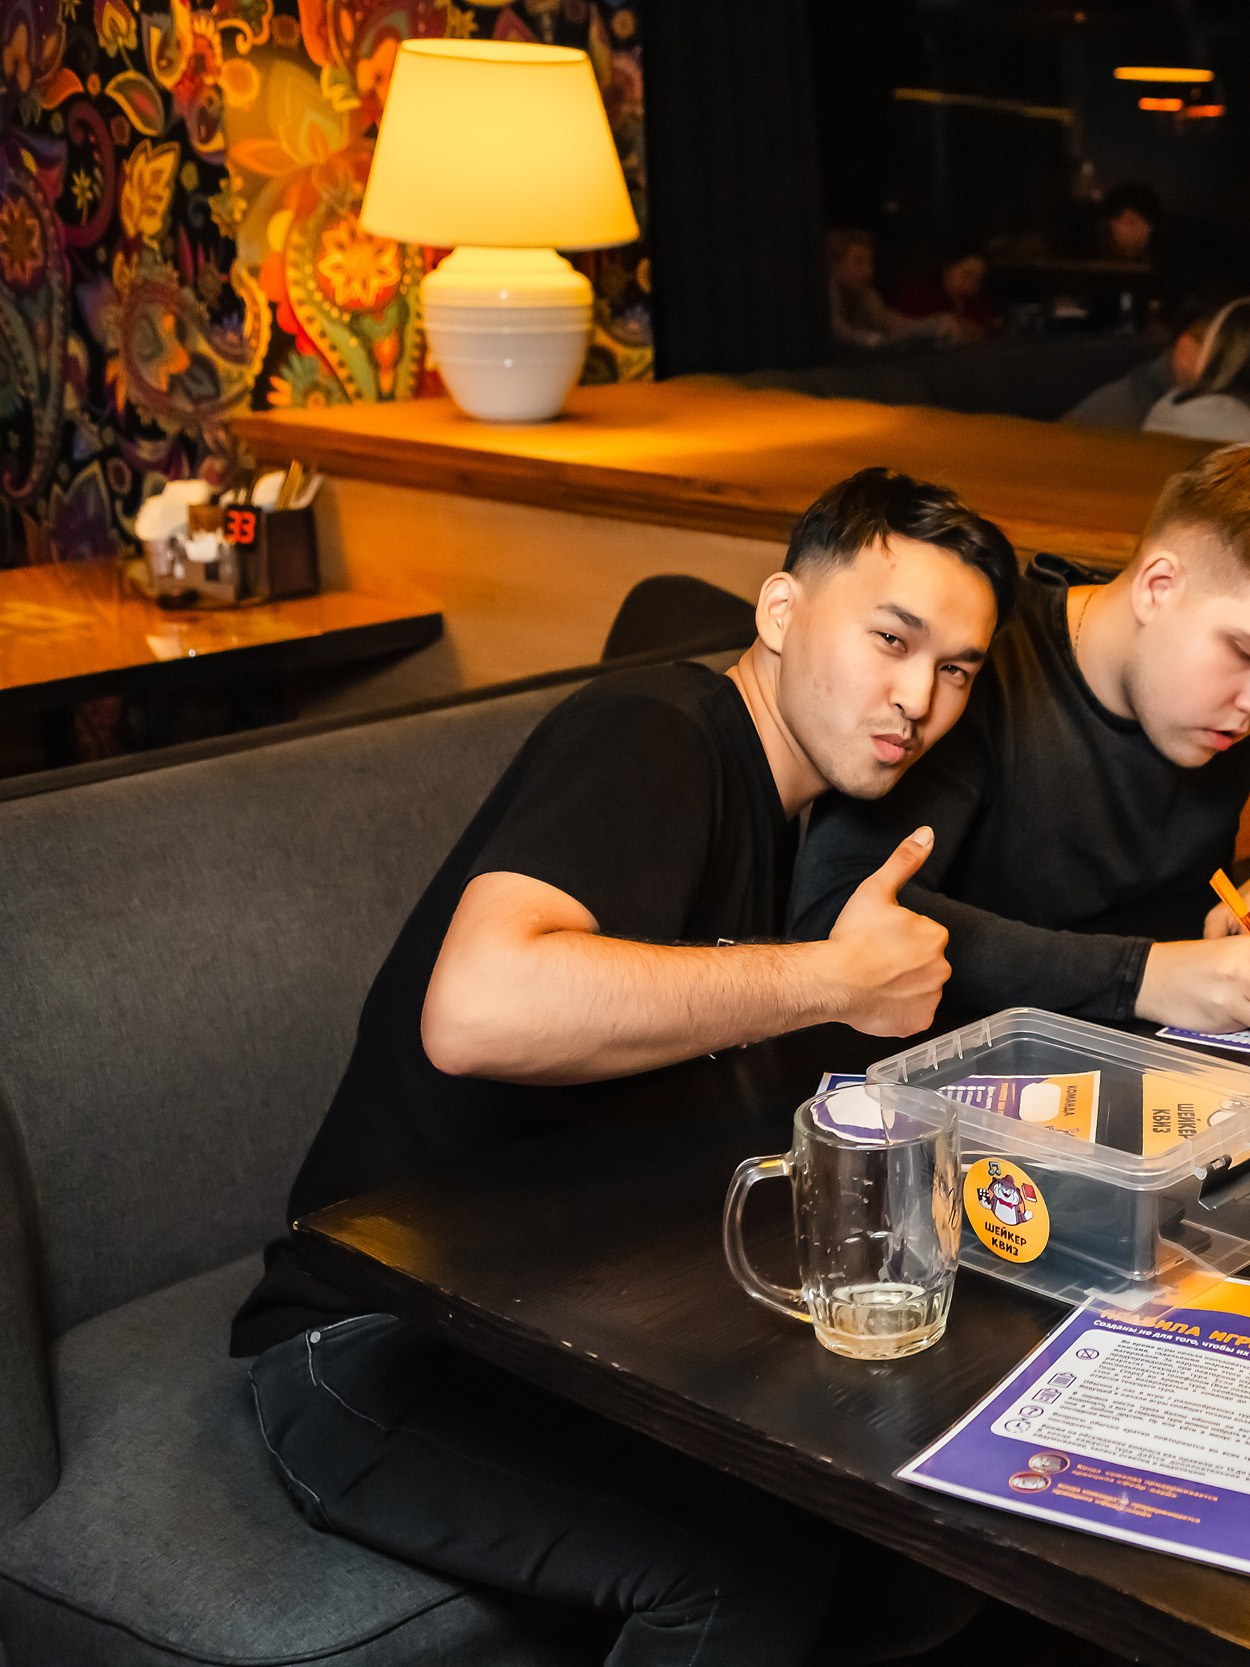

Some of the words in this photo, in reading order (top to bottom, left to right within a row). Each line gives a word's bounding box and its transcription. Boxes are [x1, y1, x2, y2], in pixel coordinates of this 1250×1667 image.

[1152, 1108, 1171, 1134] КВИЗ
[984, 1221, 1027, 1247] ШЕЙКЕР
[991, 1237, 1019, 1256] КВИЗ
[1093, 1319, 1138, 1334] Созданы
[1138, 1328, 1152, 1336] не
[1152, 1331, 1173, 1341] для
[1201, 1340, 1235, 1354] чтобы
[1236, 1348, 1249, 1357] их
